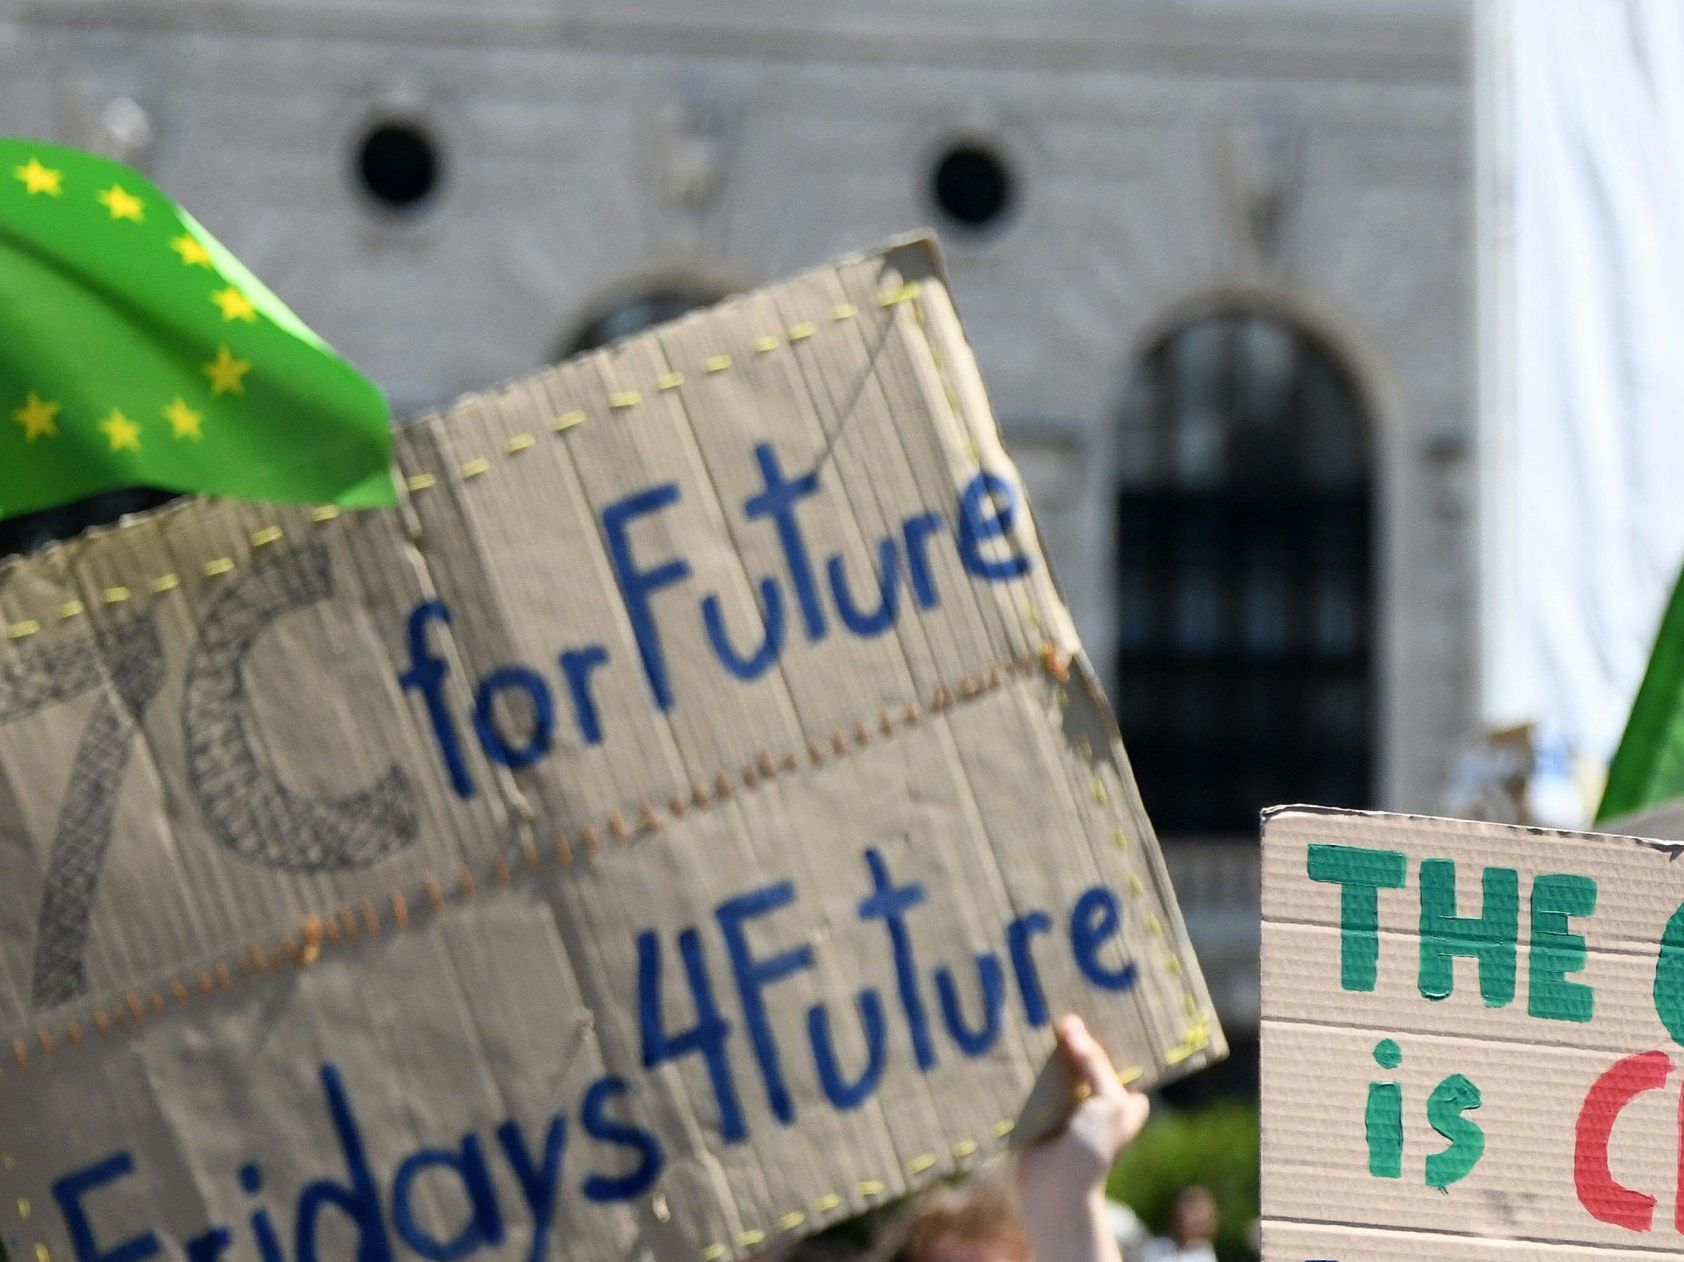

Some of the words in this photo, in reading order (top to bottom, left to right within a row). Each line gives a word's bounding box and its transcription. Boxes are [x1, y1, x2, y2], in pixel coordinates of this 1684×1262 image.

[602, 443, 1032, 711] Future
[1307, 844, 1597, 1022] THE
[1365, 1038, 1485, 1194] is
